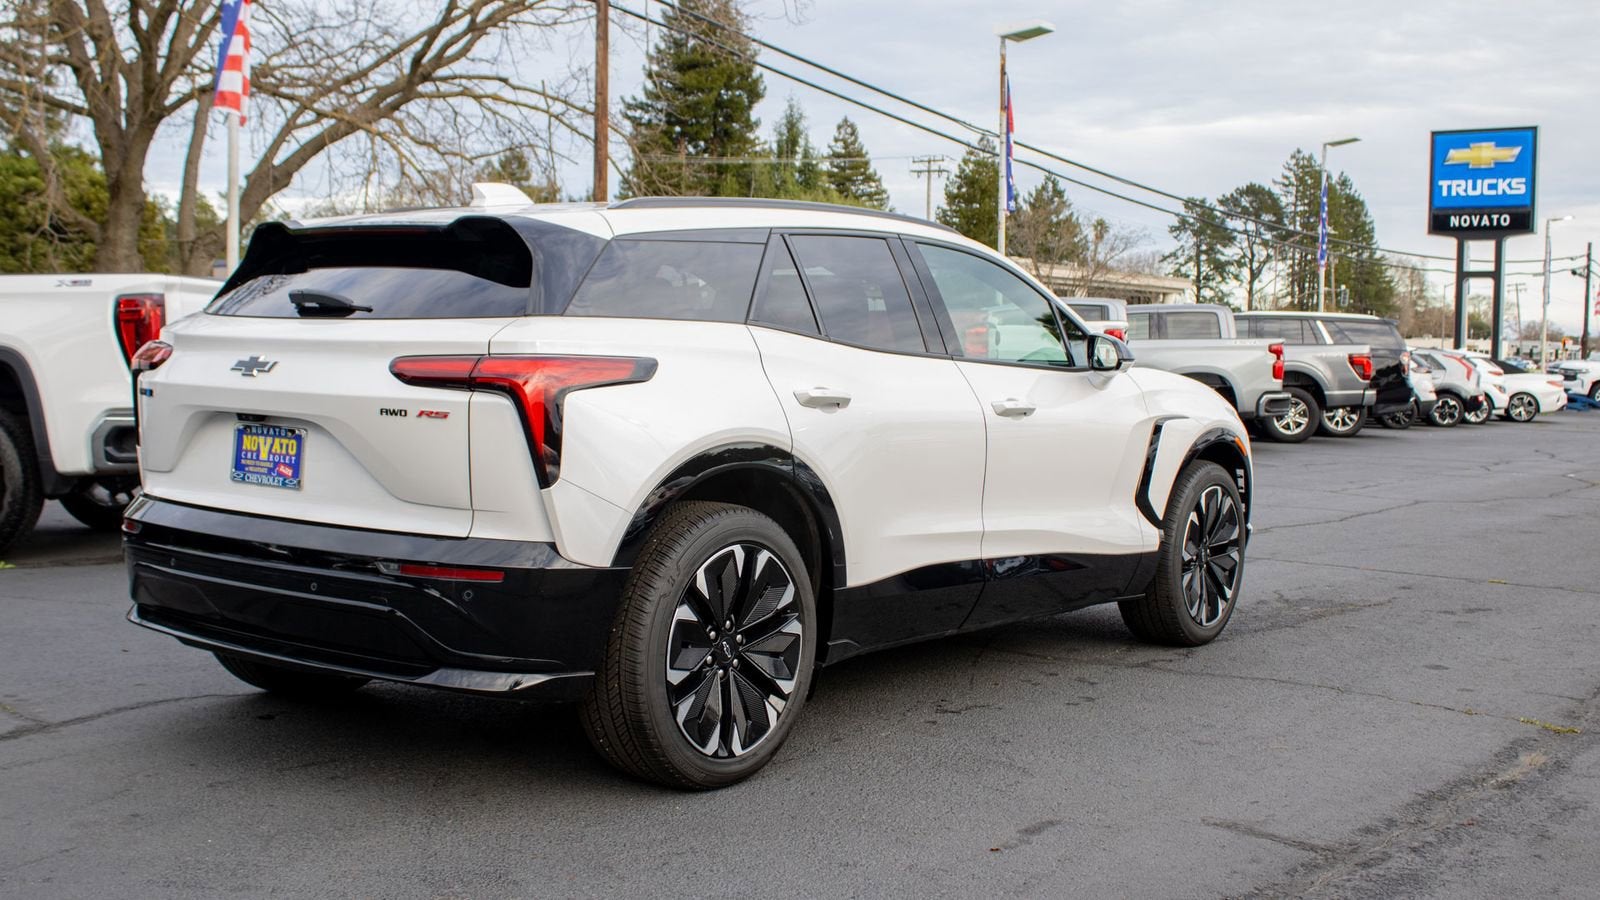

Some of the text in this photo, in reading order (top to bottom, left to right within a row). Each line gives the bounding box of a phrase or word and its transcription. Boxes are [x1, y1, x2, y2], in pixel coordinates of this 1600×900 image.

[1438, 177, 1526, 197] TRUCKS
[1450, 214, 1511, 228] NOVATO
[380, 408, 450, 420] AWD RS
[251, 426, 287, 436] NOVATO
[242, 435, 297, 460] NOVATO
[244, 473, 283, 486] CHEVROLET
